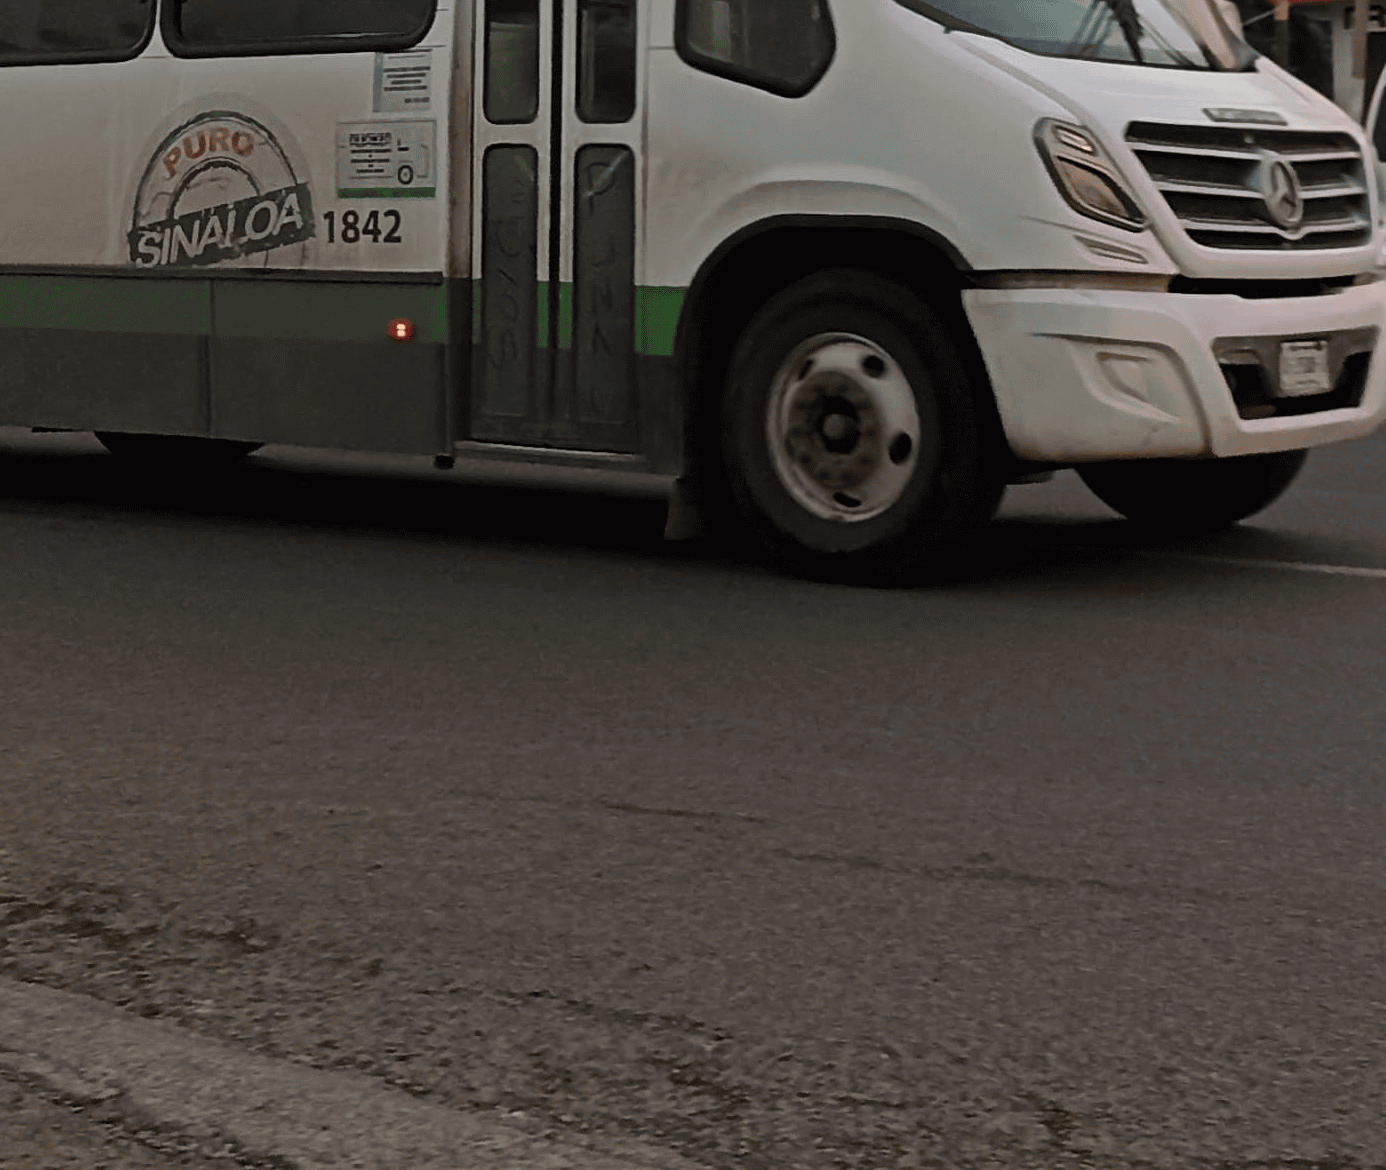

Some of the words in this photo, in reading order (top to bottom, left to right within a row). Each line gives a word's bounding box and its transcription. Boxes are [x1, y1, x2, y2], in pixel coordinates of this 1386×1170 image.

[162, 127, 256, 179] PURO
[135, 192, 306, 269] SINALOA
[323, 209, 403, 244] 1842
